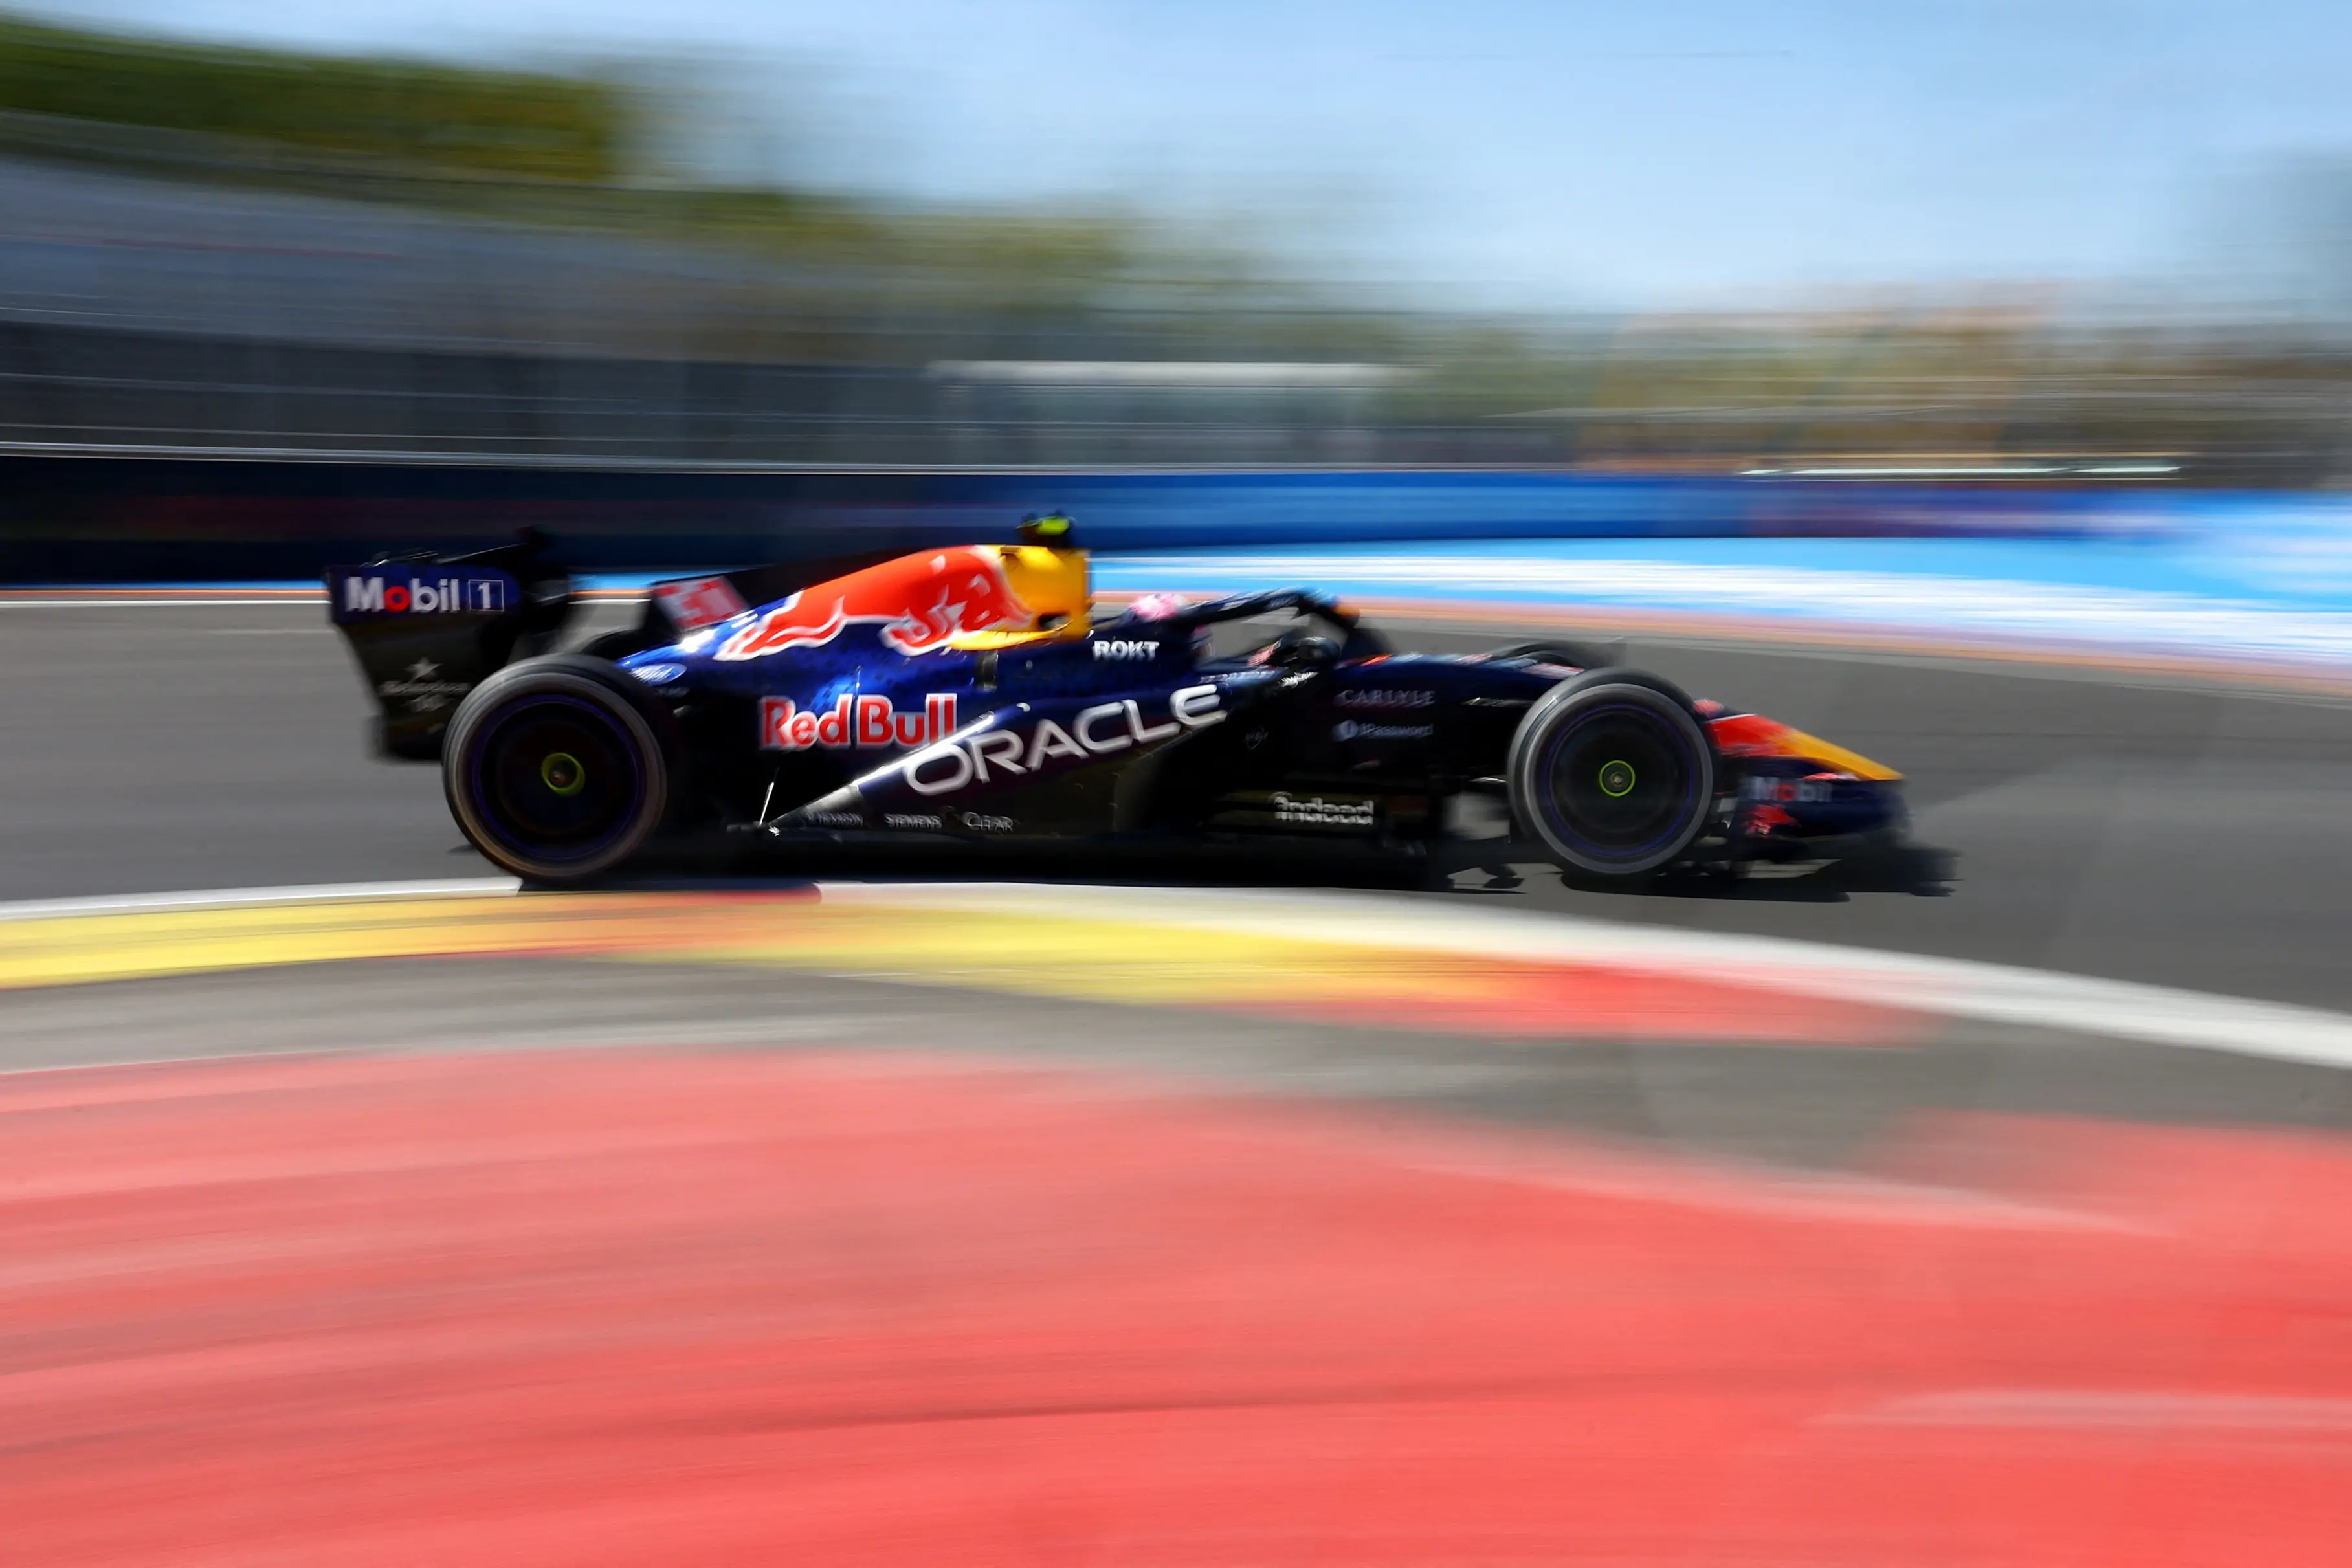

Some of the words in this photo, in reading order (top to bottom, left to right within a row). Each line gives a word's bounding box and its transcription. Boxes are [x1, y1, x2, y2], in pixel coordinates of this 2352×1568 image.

[345, 576, 460, 613] Mobil
[1092, 639, 1159, 661] ROKT
[1336, 689, 1436, 707] CARLYLE
[904, 683, 1228, 796] ORACLE
[884, 813, 942, 829] SIEMENS
